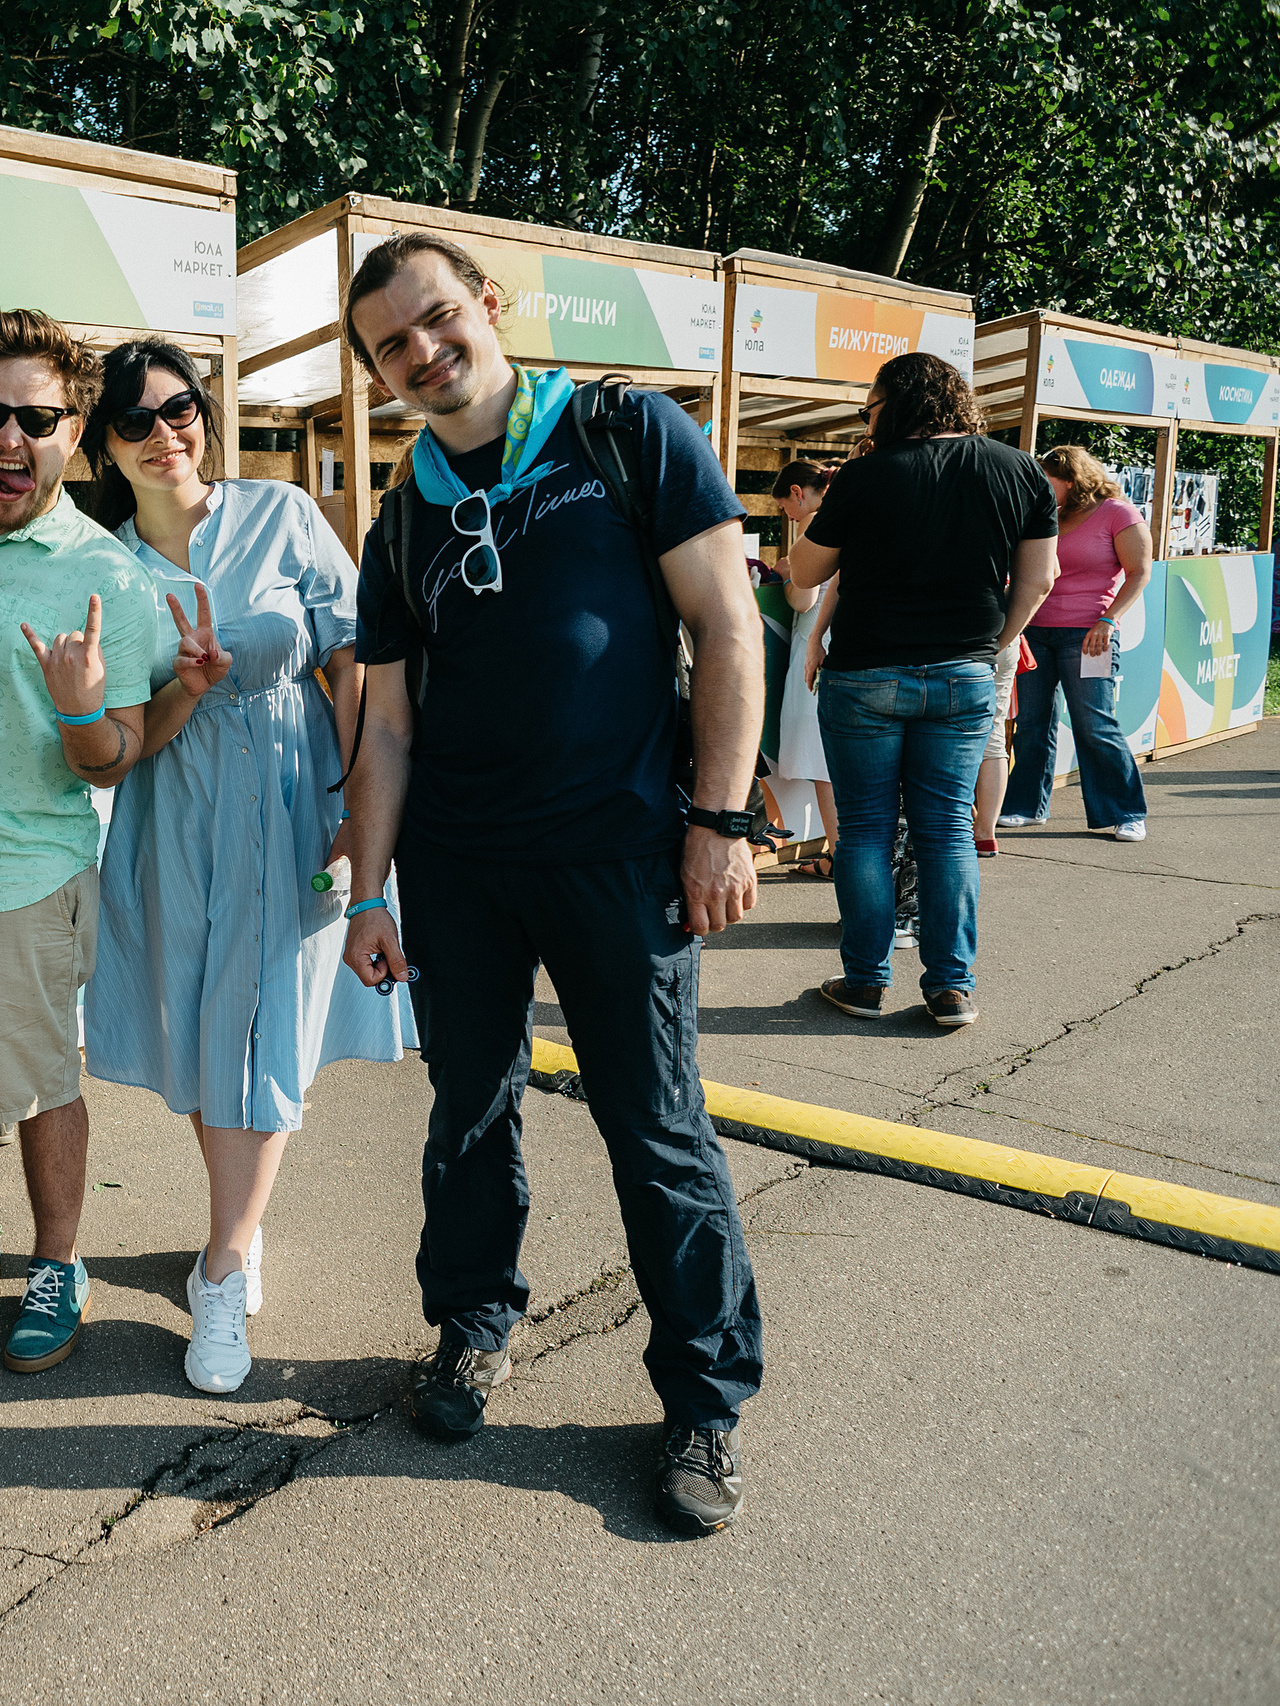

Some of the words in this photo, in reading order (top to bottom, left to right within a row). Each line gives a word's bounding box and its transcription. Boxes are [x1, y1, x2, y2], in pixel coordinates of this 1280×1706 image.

[194, 240, 223, 256] ЮЛА
[173, 259, 223, 277] МАРКЕТ
[517, 290, 617, 327] ИГРУШКИ
[690, 317, 716, 330] МАРКЕТ
[744, 338, 764, 351] юла
[828, 326, 909, 356] БИЖУТЕРИЯ
[1100, 367, 1136, 392] ОДЕЖДА
[1218, 385, 1254, 405] КОСМЕТИКА
[421, 515, 518, 634] Go
[1199, 619, 1223, 646] ЮЛА
[1196, 653, 1241, 685] МАРКЕТ
